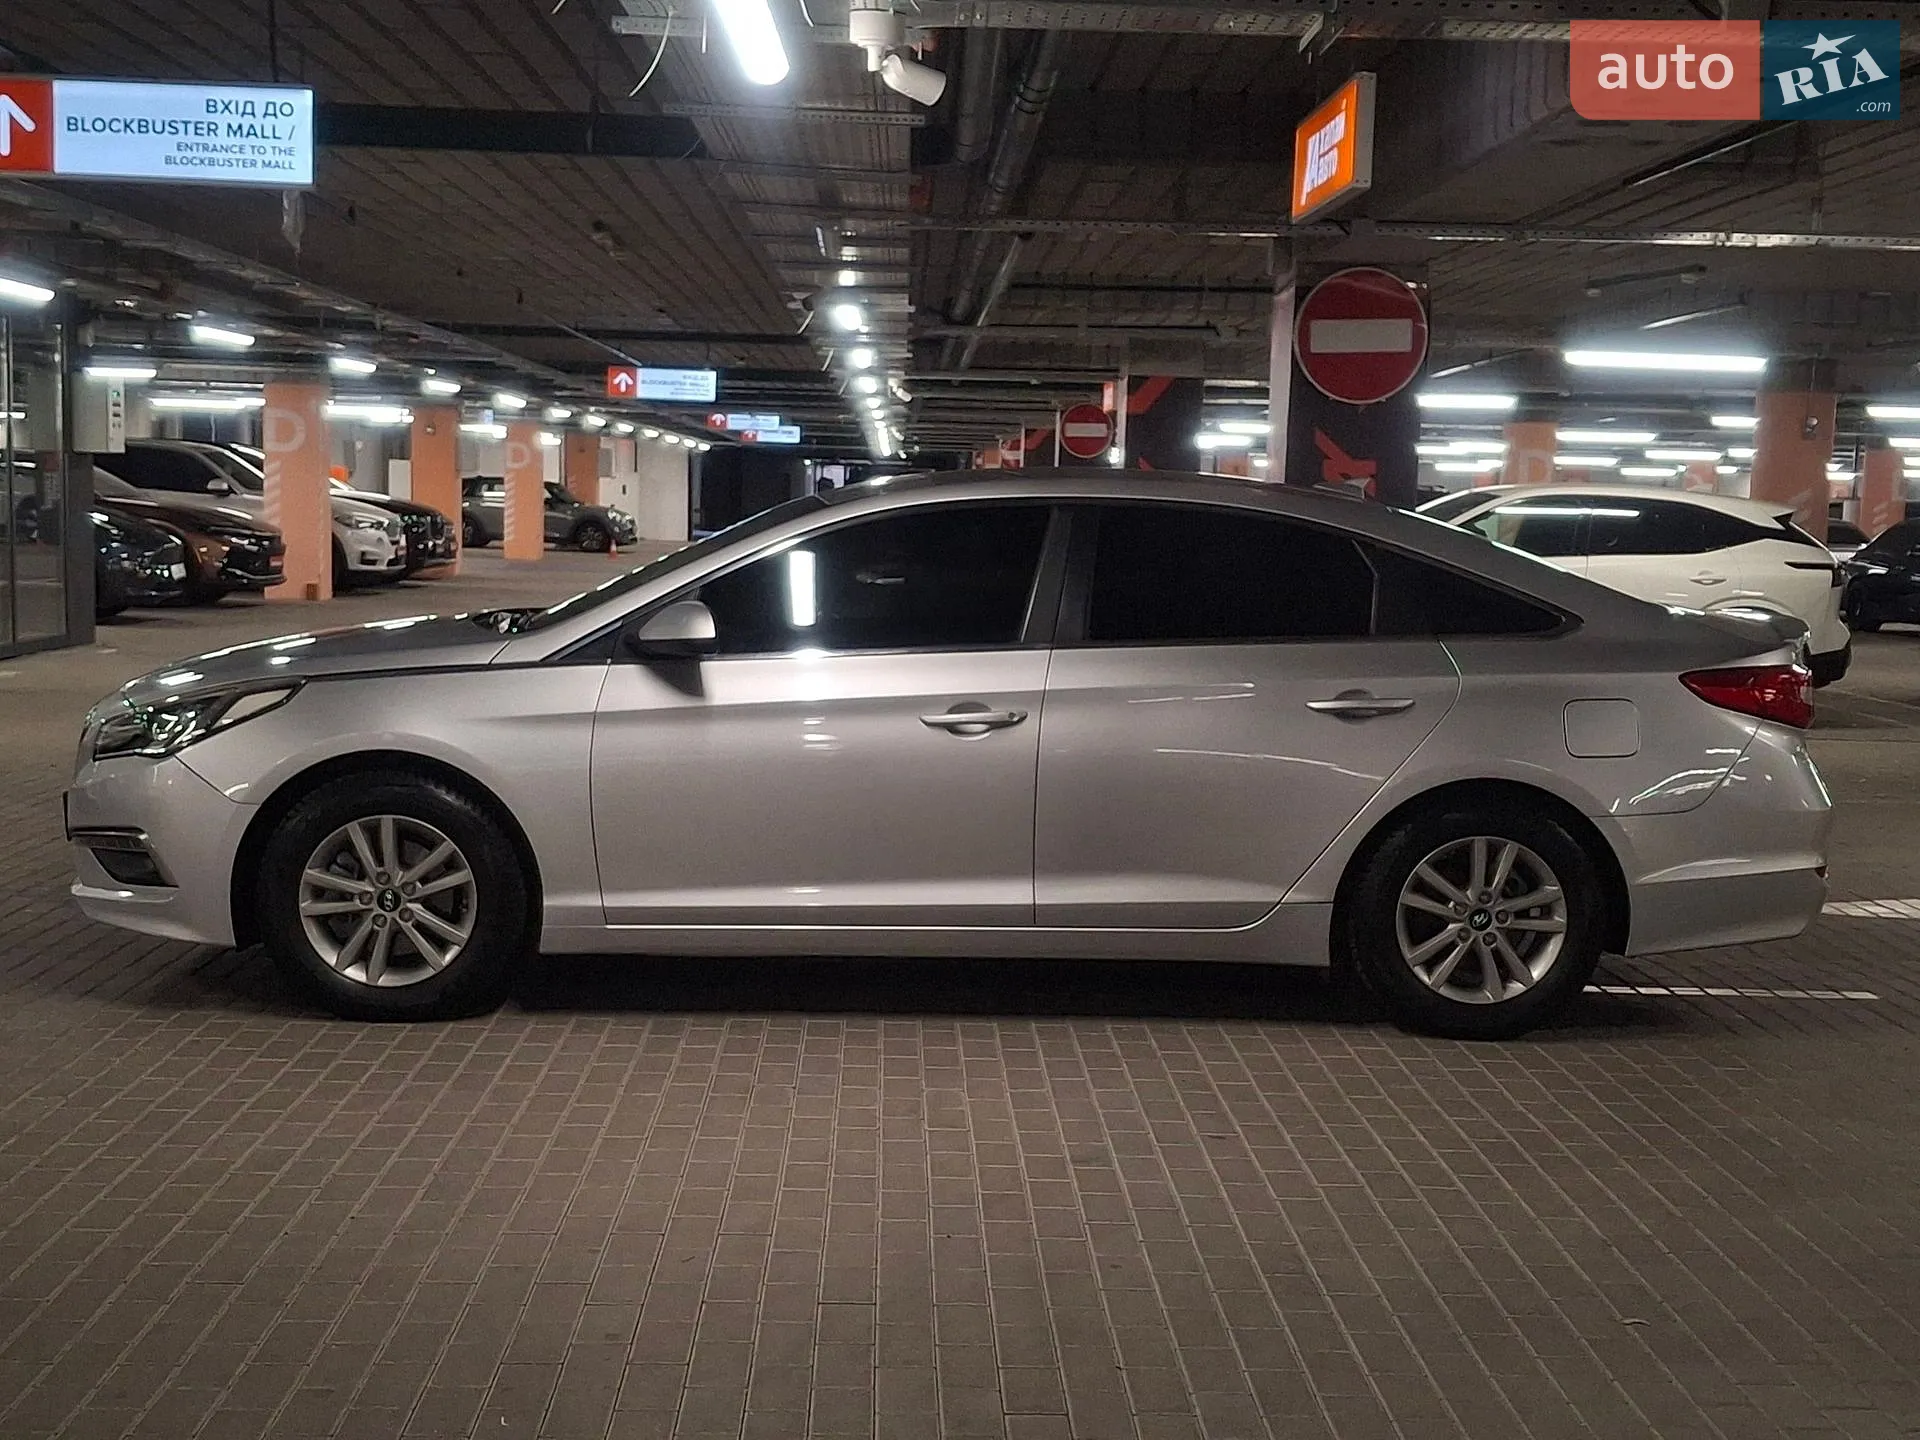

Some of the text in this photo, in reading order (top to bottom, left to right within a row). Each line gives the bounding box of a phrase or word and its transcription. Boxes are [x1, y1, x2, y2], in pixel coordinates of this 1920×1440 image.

[206, 98, 294, 119] ВХІД ДО
[66, 116, 218, 138] BLOCKBUSTER
[226, 122, 282, 140] MALL
[176, 141, 296, 157] ENTRANCE TO THE
[164, 155, 296, 170] BLOCKBUSTER MALL
[263, 408, 306, 452] D
